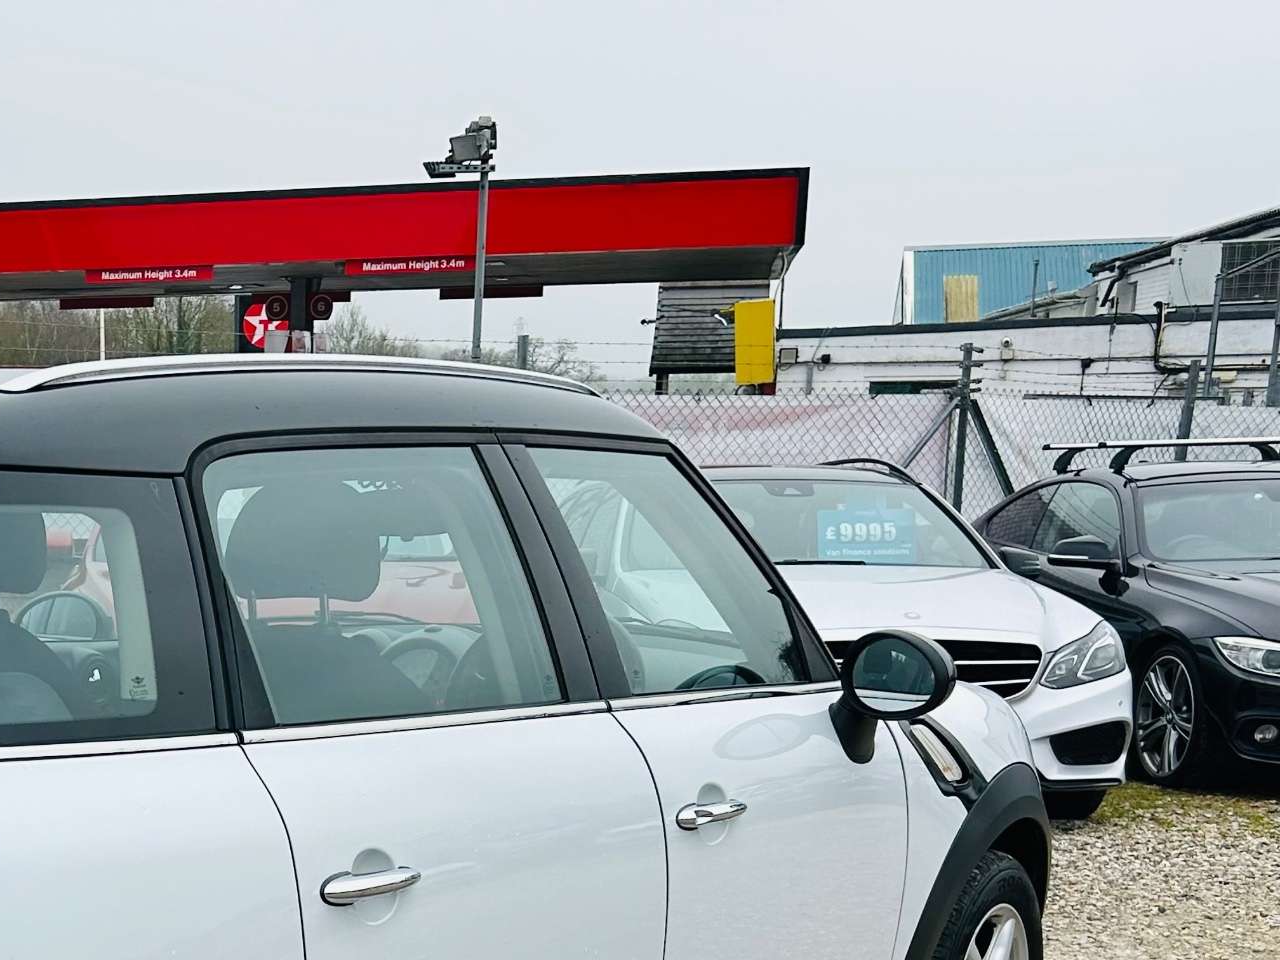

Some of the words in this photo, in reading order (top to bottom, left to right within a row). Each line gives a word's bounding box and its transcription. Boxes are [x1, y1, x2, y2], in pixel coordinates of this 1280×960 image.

[363, 262, 406, 271] Maximum
[409, 260, 439, 270] Height
[440, 259, 465, 268] 3.4m
[101, 271, 142, 280] Maximum
[144, 270, 173, 280] Height
[174, 269, 196, 278] 3.4m
[273, 302, 280, 312] 5
[317, 302, 325, 311] 6
[825, 522, 896, 541] £9995
